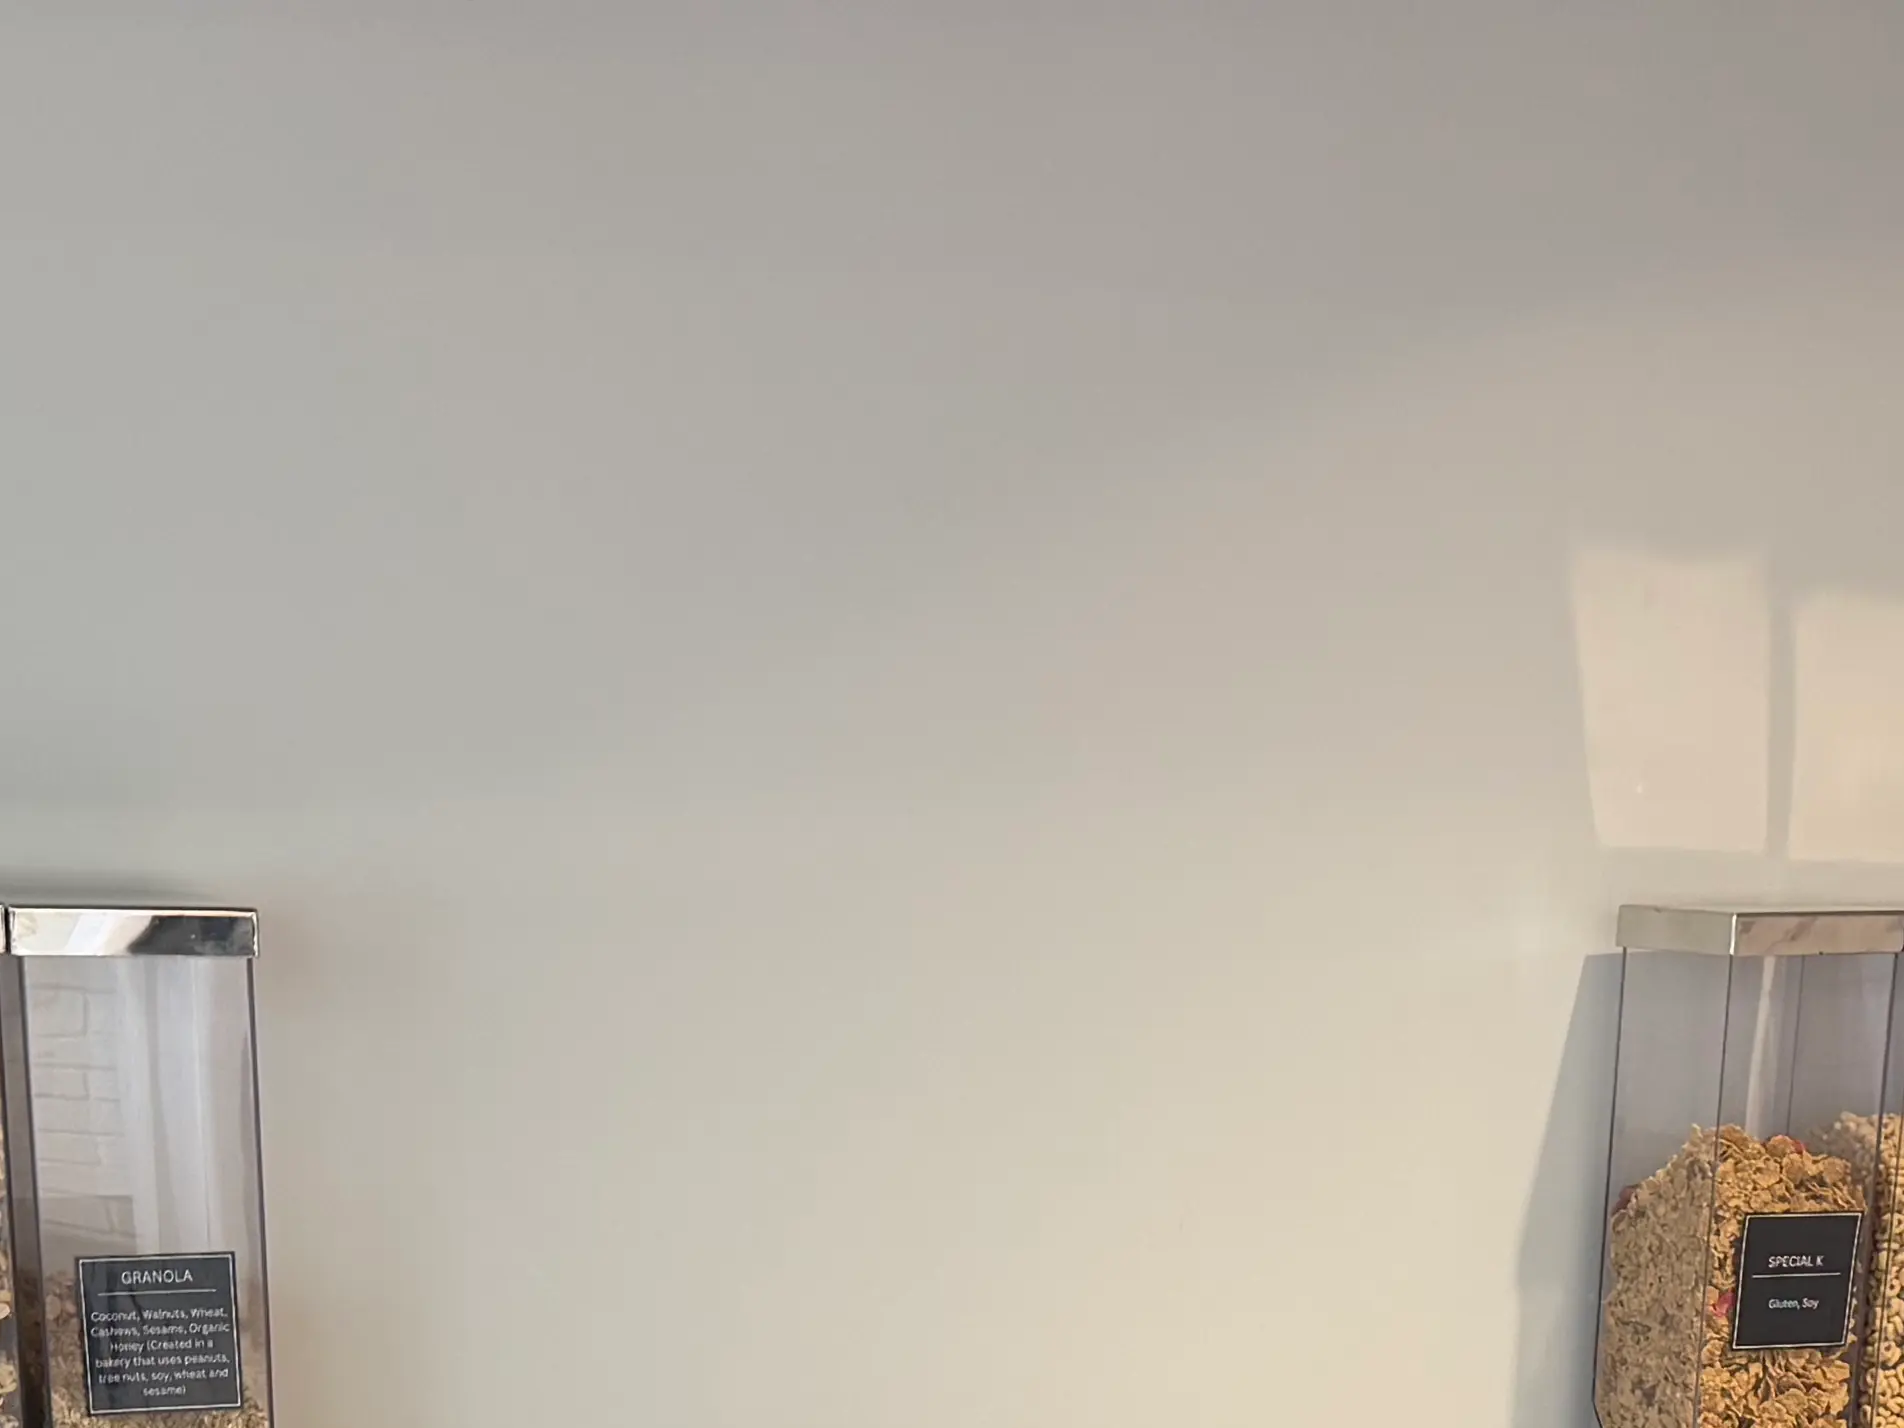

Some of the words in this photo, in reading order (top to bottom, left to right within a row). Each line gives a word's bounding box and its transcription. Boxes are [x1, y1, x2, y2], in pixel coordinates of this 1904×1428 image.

[1768, 1256, 1814, 1268] SPECIAL
[1816, 1255, 1824, 1267] K
[121, 1269, 193, 1285] GRANOLA
[1768, 1298, 1800, 1310] Gluten,
[1802, 1297, 1819, 1310] Soy
[189, 1323, 230, 1335] Organic
[133, 1355, 155, 1366] that
